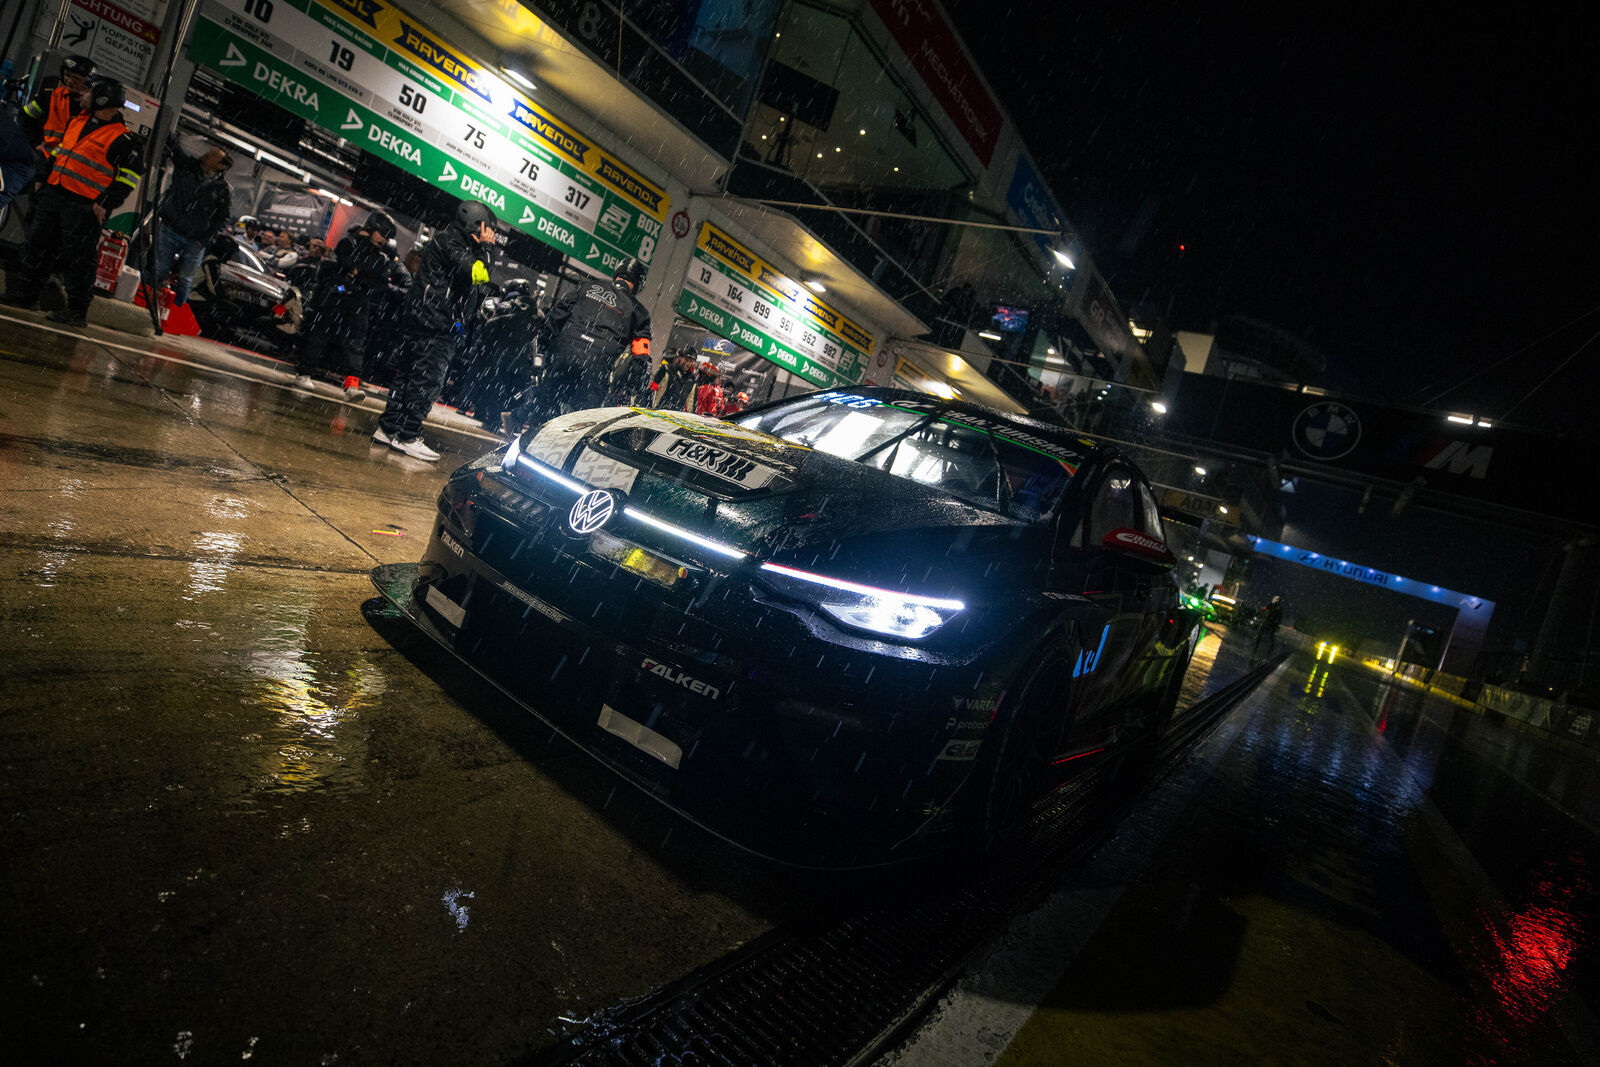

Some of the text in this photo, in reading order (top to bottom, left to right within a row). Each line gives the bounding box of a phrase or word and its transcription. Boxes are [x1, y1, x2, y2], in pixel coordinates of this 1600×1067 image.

[80, 0, 144, 33] CHTUNG
[577, 2, 601, 40] 8
[329, 40, 355, 72] 19
[405, 33, 489, 98] RAVENOL
[252, 61, 320, 113] DEKRA
[398, 83, 427, 114] 50
[464, 123, 487, 150] 75
[514, 105, 581, 157] RAVENOL
[367, 123, 423, 168] DEKRA
[519, 157, 540, 182] 76
[460, 174, 505, 211] DEKRA
[564, 185, 591, 211] 317
[602, 164, 656, 206] RAVENOL
[536, 216, 576, 249] DEKRA
[636, 213, 661, 239] BOX
[637, 235, 656, 263] 8
[710, 236, 751, 269] RAVENOL
[700, 267, 712, 285] 13
[727, 283, 744, 304] 164
[699, 305, 725, 330] DEKRA
[753, 300, 771, 320] 899
[740, 327, 764, 350] DEKRA
[780, 317, 794, 333] 961
[801, 330, 817, 347] 962
[776, 348, 798, 368] DEKRA
[822, 342, 838, 359] 982
[808, 366, 828, 382] DEKRA
[668, 438, 723, 467] H&R
[991, 422, 1084, 459] TURISMO
[1424, 440, 1496, 480] M
[440, 530, 465, 558] FALKEN
[1323, 558, 1390, 586] HYUNDAI
[641, 656, 721, 701] FALKEN
[966, 696, 996, 712] VARTA
